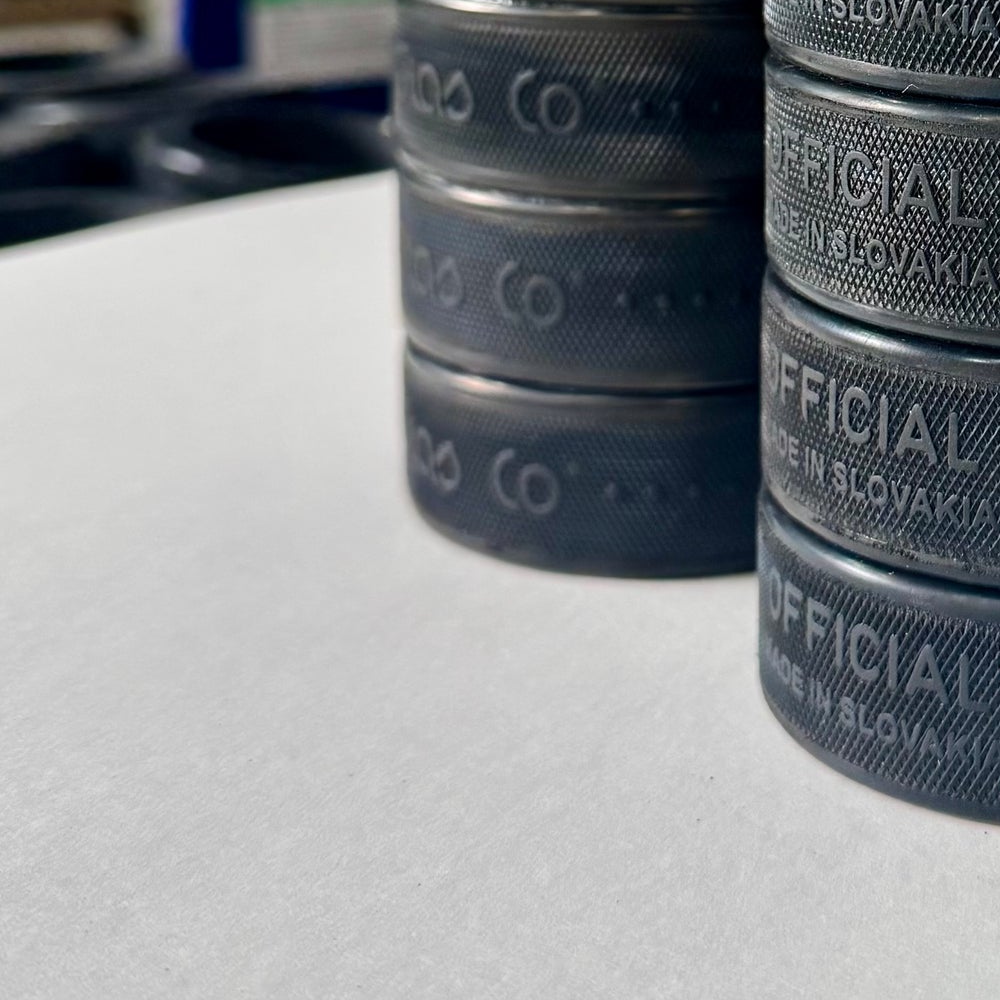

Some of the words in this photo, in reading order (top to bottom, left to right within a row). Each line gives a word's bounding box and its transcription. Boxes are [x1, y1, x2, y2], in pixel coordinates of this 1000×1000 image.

[509, 69, 580, 133] Co
[806, 216, 825, 251] IN
[832, 229, 1000, 290] SLOVAKIA
[493, 448, 560, 515] Co
[805, 446, 825, 485] IN
[832, 462, 999, 531] SLOVAKIA
[769, 568, 991, 713] OFFICIAL
[809, 678, 832, 717] IN
